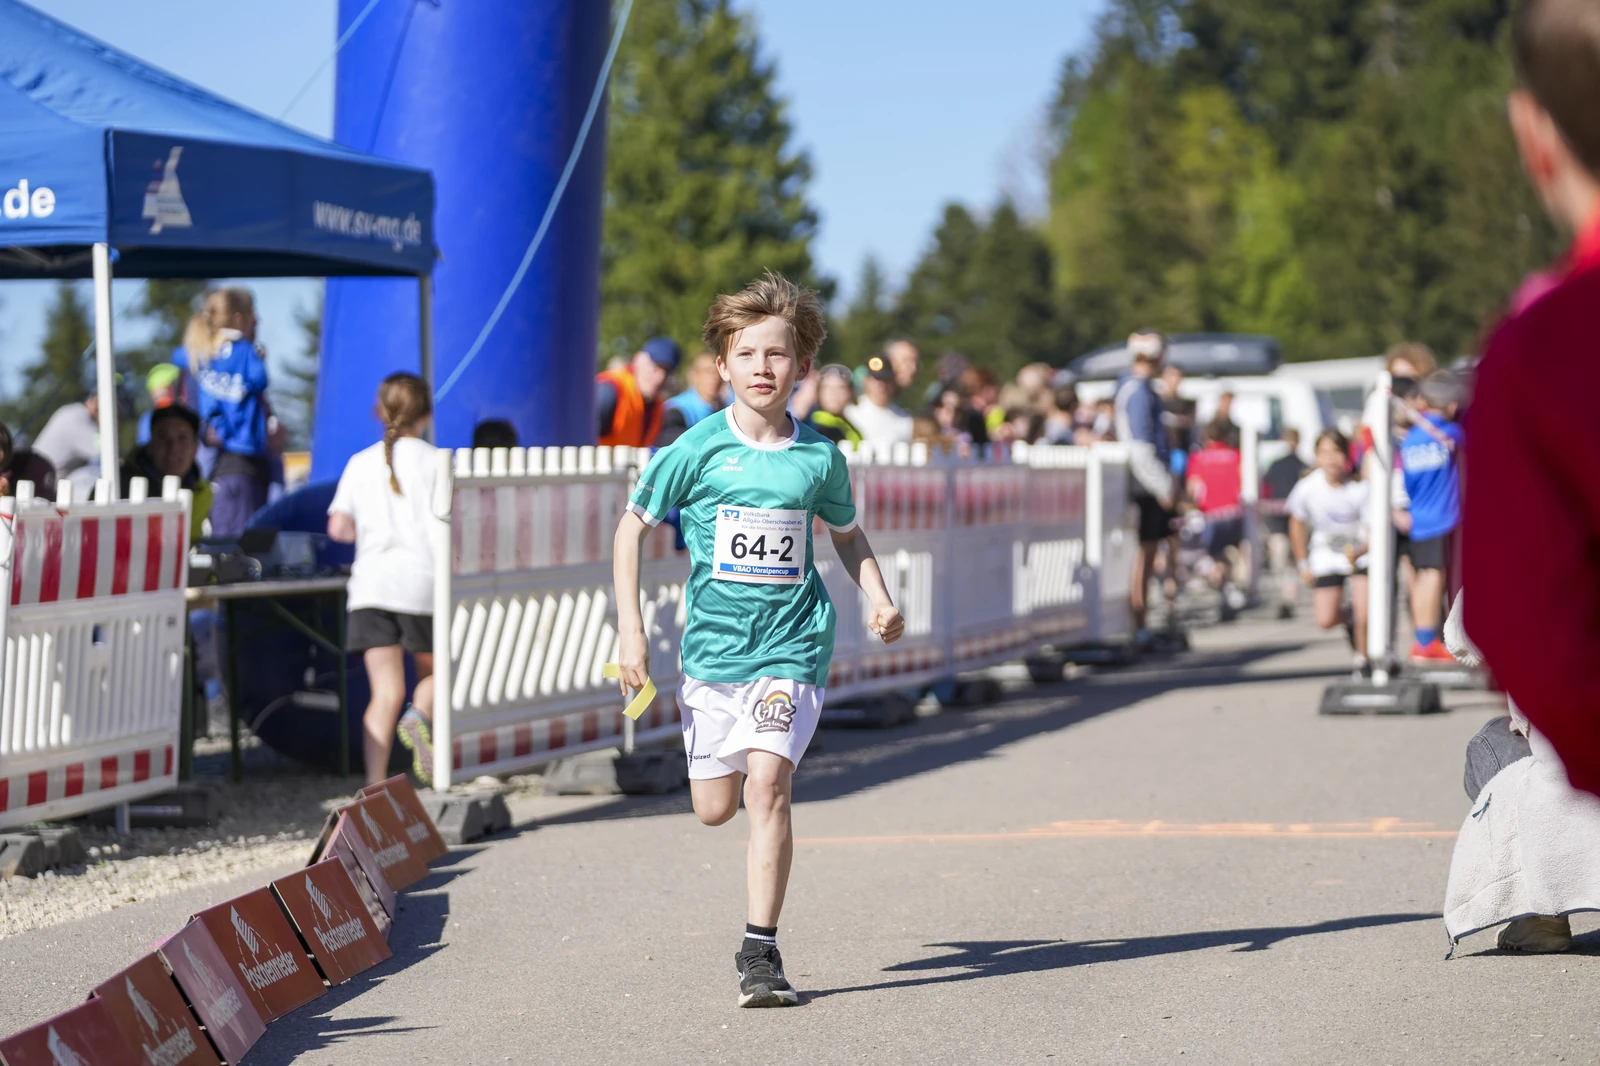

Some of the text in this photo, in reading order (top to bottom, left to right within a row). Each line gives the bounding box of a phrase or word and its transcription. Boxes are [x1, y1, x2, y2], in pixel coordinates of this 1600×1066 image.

[0, 178, 56, 219] de
[743, 517, 797, 525] Allgäu-Oberschwaben
[731, 532, 794, 562] 64-2
[733, 564, 790, 576] VBAO Voralpencup
[754, 701, 796, 723] GITZ
[238, 943, 300, 992] Poschenrieder
